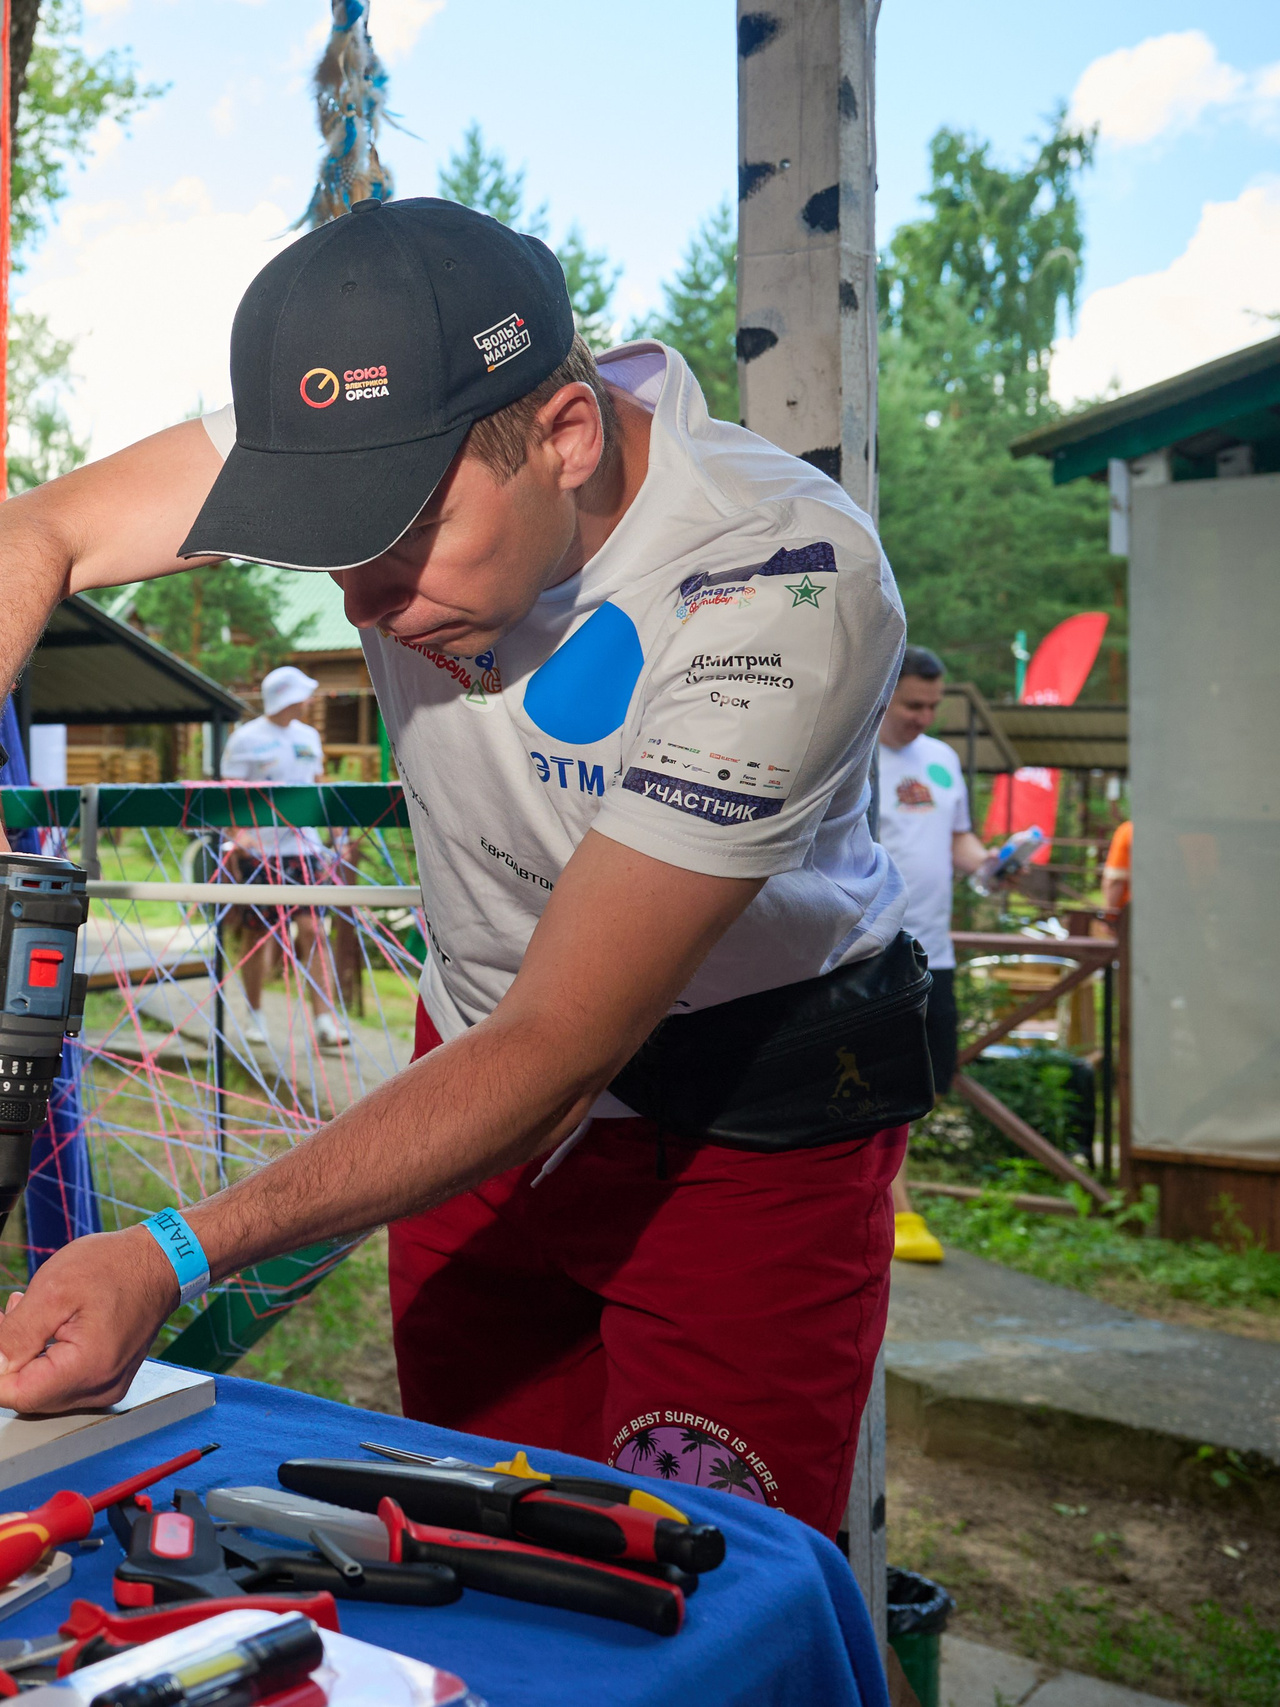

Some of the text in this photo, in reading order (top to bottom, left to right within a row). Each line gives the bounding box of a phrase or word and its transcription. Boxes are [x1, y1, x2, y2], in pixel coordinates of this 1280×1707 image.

[482, 321, 519, 351] ВОЛЬТ
[483, 331, 528, 366] МАРКЕТ
[343, 365, 388, 383] СОЮЗ
[344, 378, 388, 390] ЭЛЕКТРИКОВ
[345, 386, 390, 402] ОРСКА
[684, 585, 746, 607] Самара
[691, 653, 782, 670] Дмитрий
[710, 691, 750, 709] Орск
[530, 751, 606, 797] ЭТМ
[642, 781, 758, 821] УЧАСТНИК
[612, 1410, 779, 1492] THE BEST SURFING IS HERE
